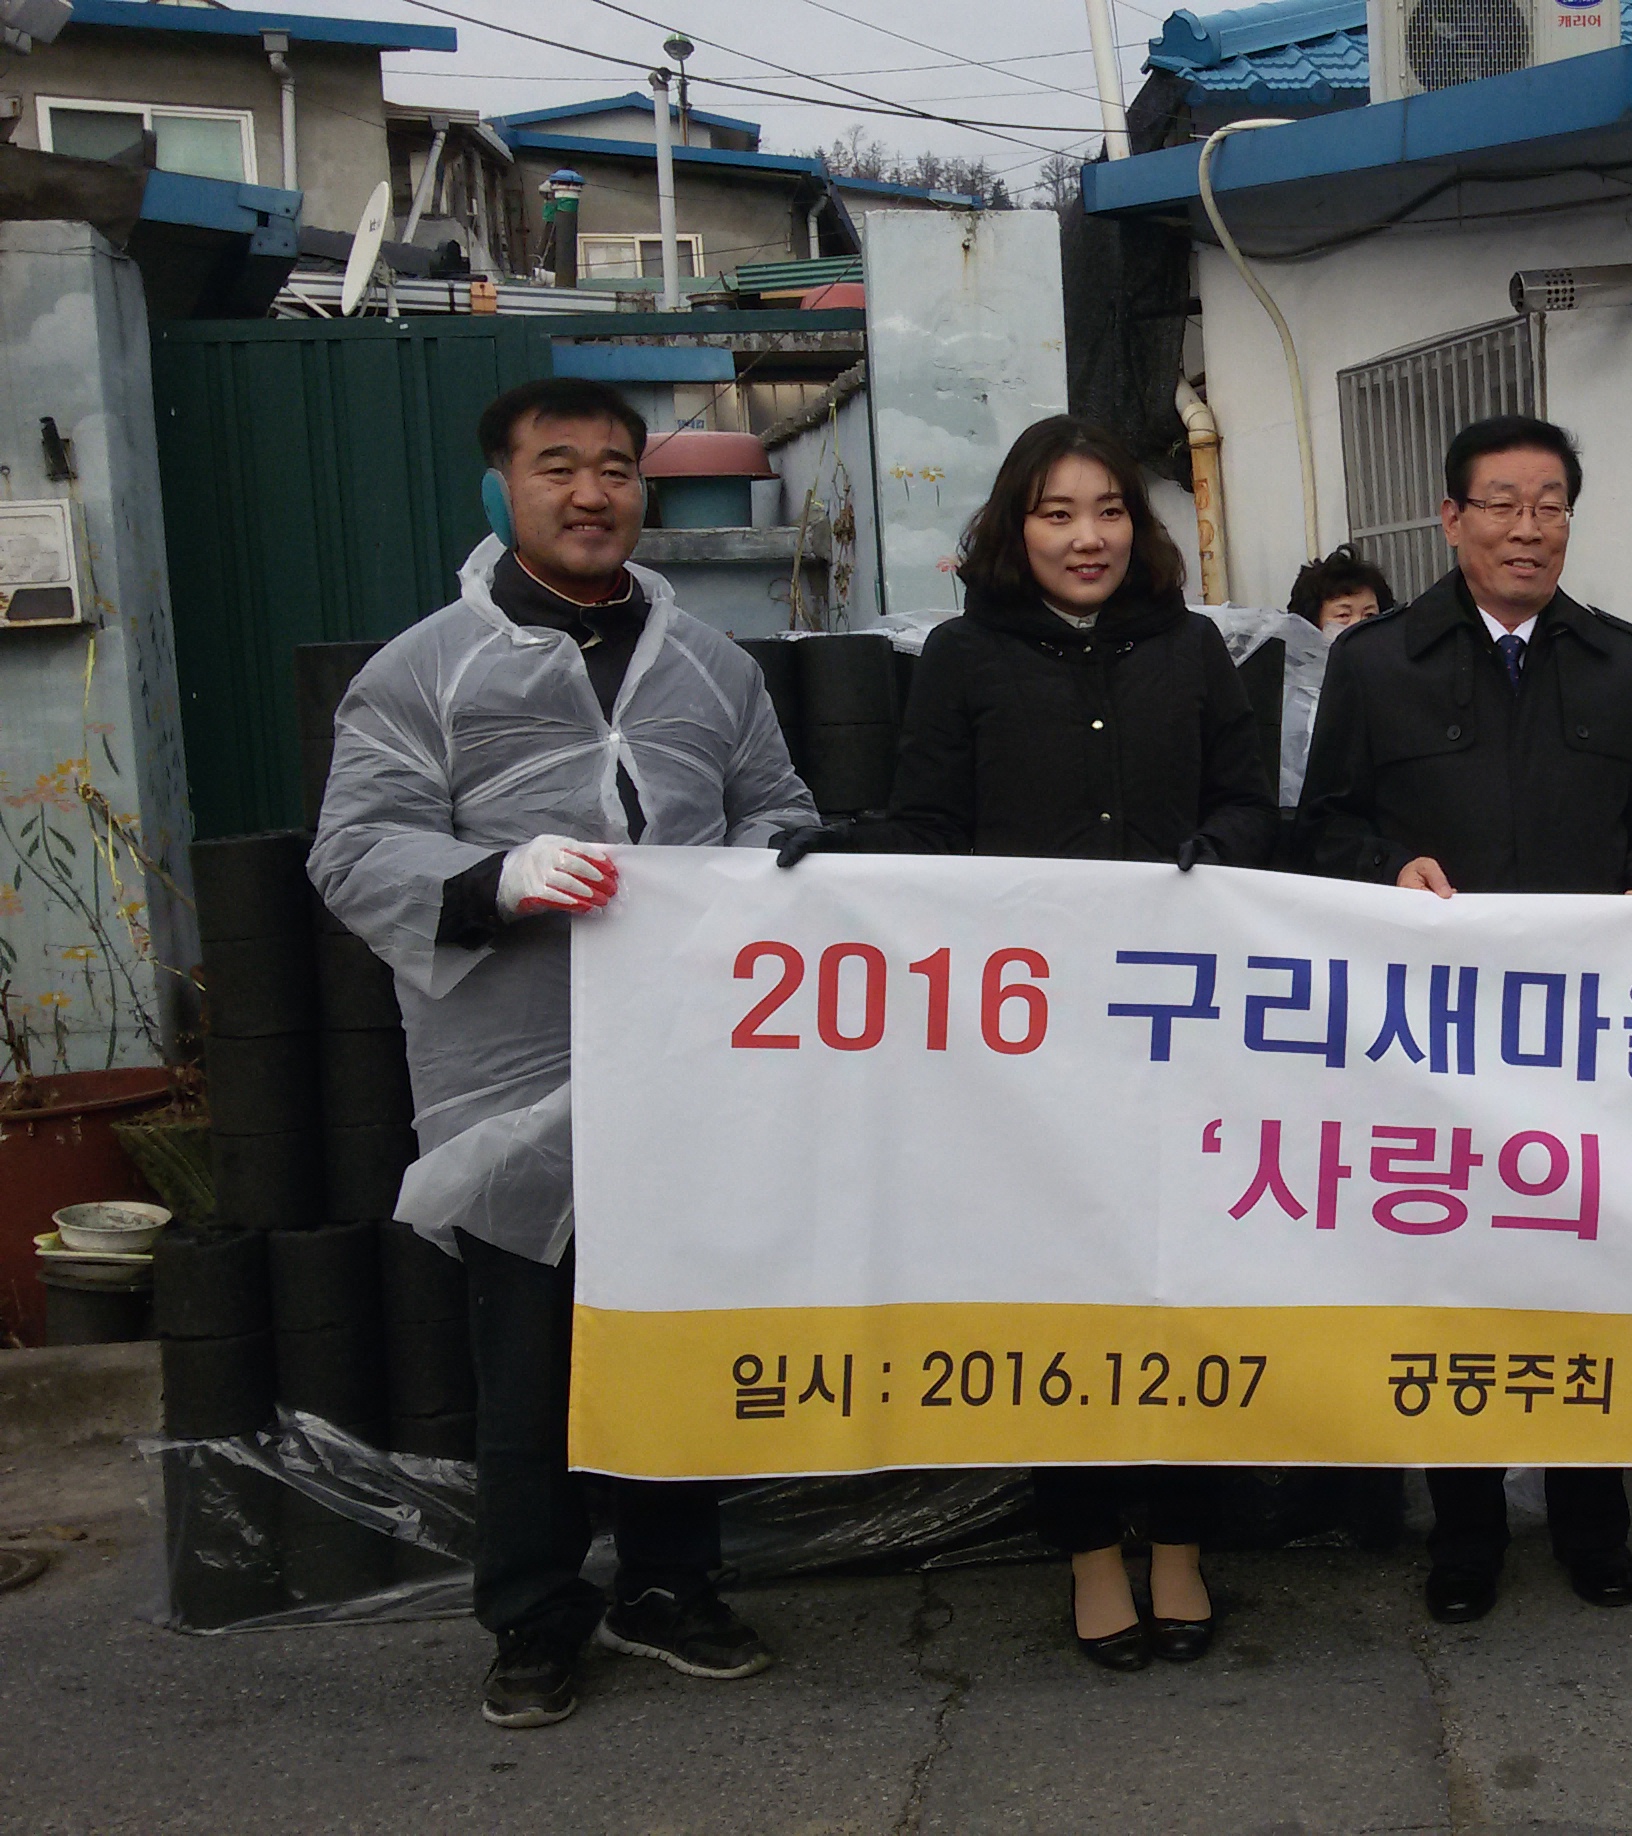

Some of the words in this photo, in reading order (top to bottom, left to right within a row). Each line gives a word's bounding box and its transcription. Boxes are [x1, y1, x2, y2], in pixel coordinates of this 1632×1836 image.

[1558, 14, 1601, 28] 캐리어
[732, 941, 1050, 1055] 2016
[921, 1351, 1267, 1408] 2016.12.07
